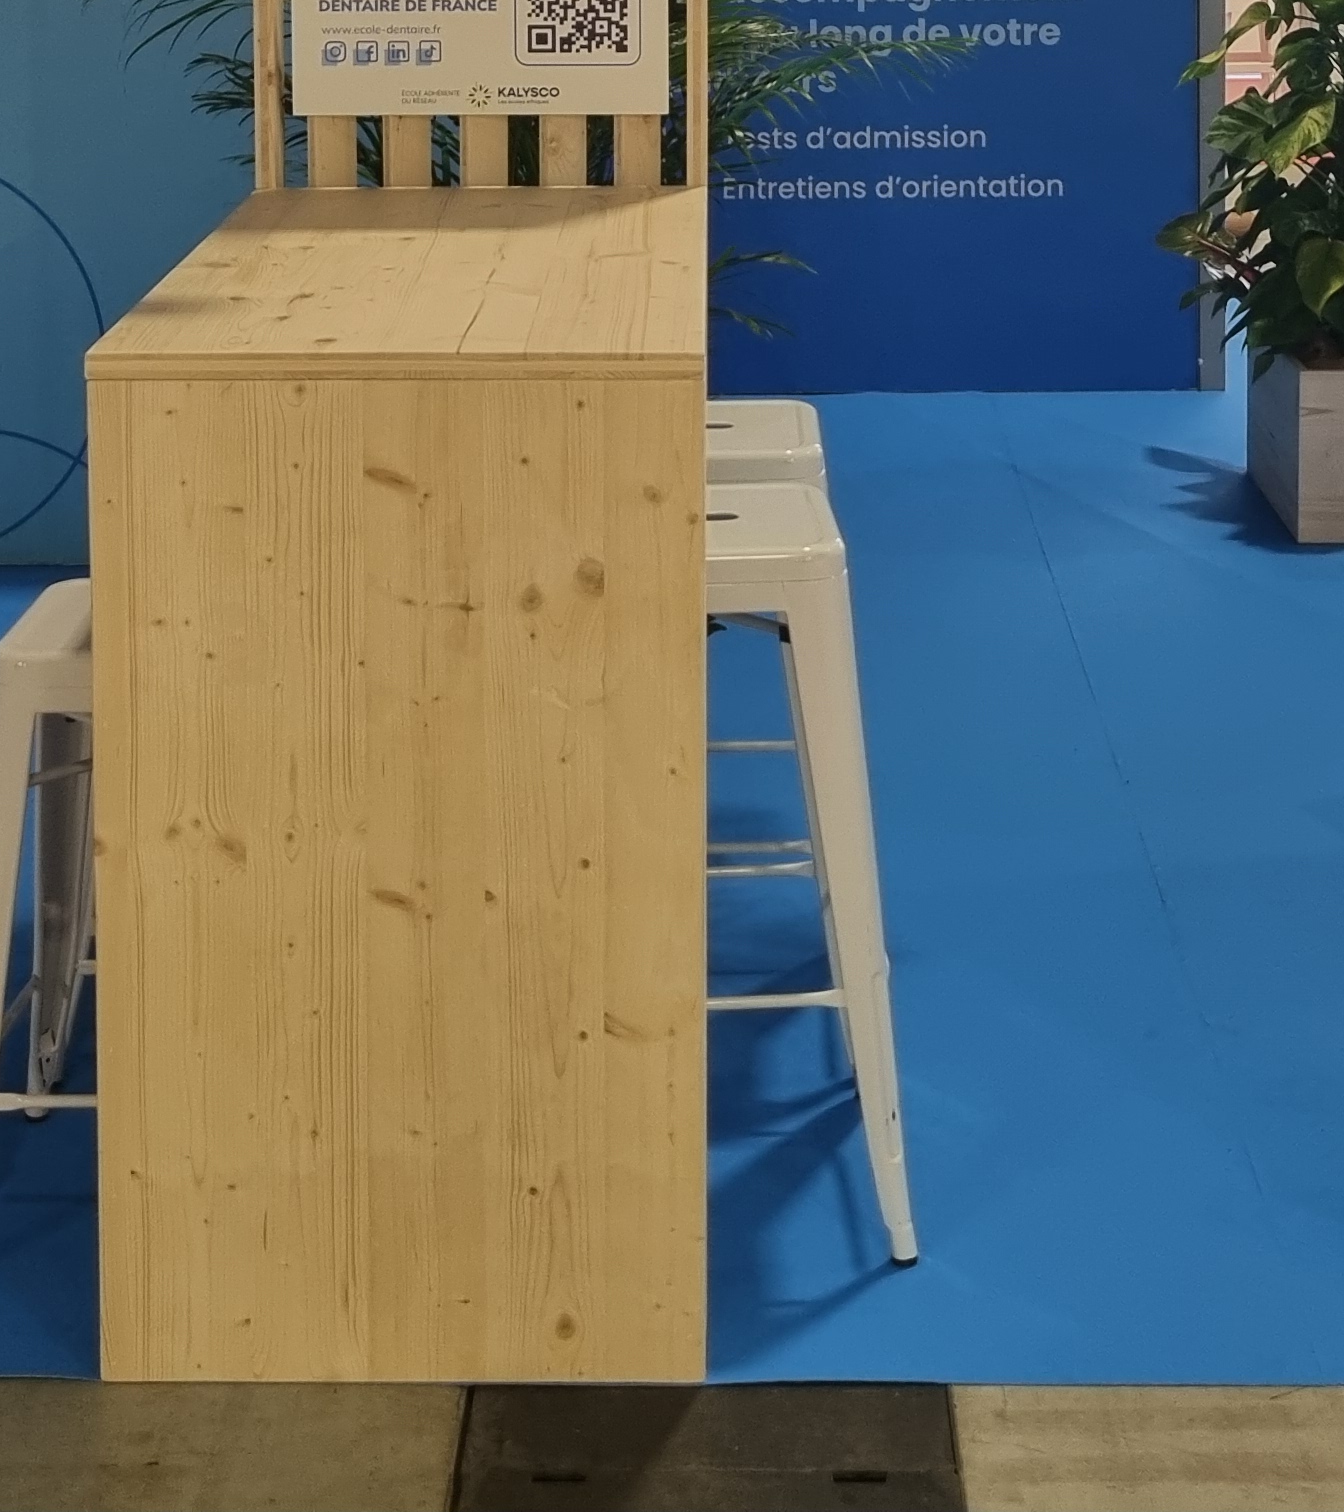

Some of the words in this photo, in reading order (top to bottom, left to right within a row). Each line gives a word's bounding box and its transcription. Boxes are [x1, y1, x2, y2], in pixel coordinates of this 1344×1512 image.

[319, 0, 400, 12] DENTAIRE
[406, 0, 426, 12] DE
[432, 0, 497, 12] FRANCE
[321, 24, 442, 36] www.ecole-dentaire.fr
[903, 18, 950, 46] de
[960, 18, 1060, 46] votre
[497, 87, 560, 98] KALYSCO
[806, 124, 986, 150] d'admission
[723, 177, 866, 200] Entretiens
[876, 174, 1063, 199] d'orientation
